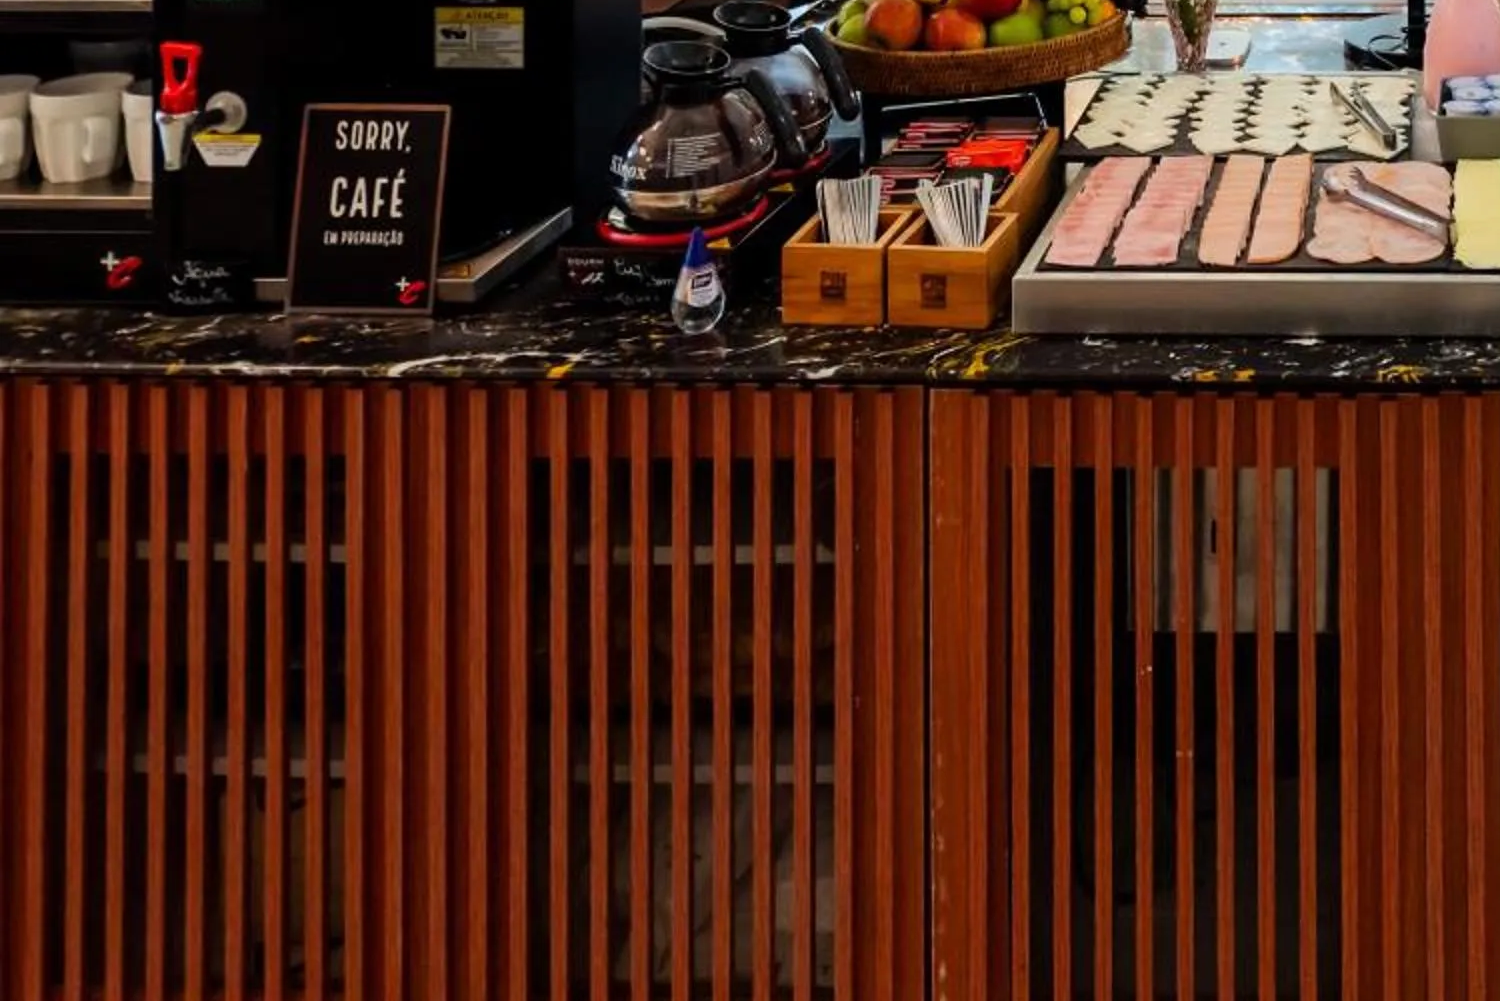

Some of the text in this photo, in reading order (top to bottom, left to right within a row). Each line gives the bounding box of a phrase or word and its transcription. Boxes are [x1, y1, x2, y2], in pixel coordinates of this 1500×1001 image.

[329, 168, 407, 219] CAFÉ
[322, 228, 405, 248] EM PREPARAÇÃO
